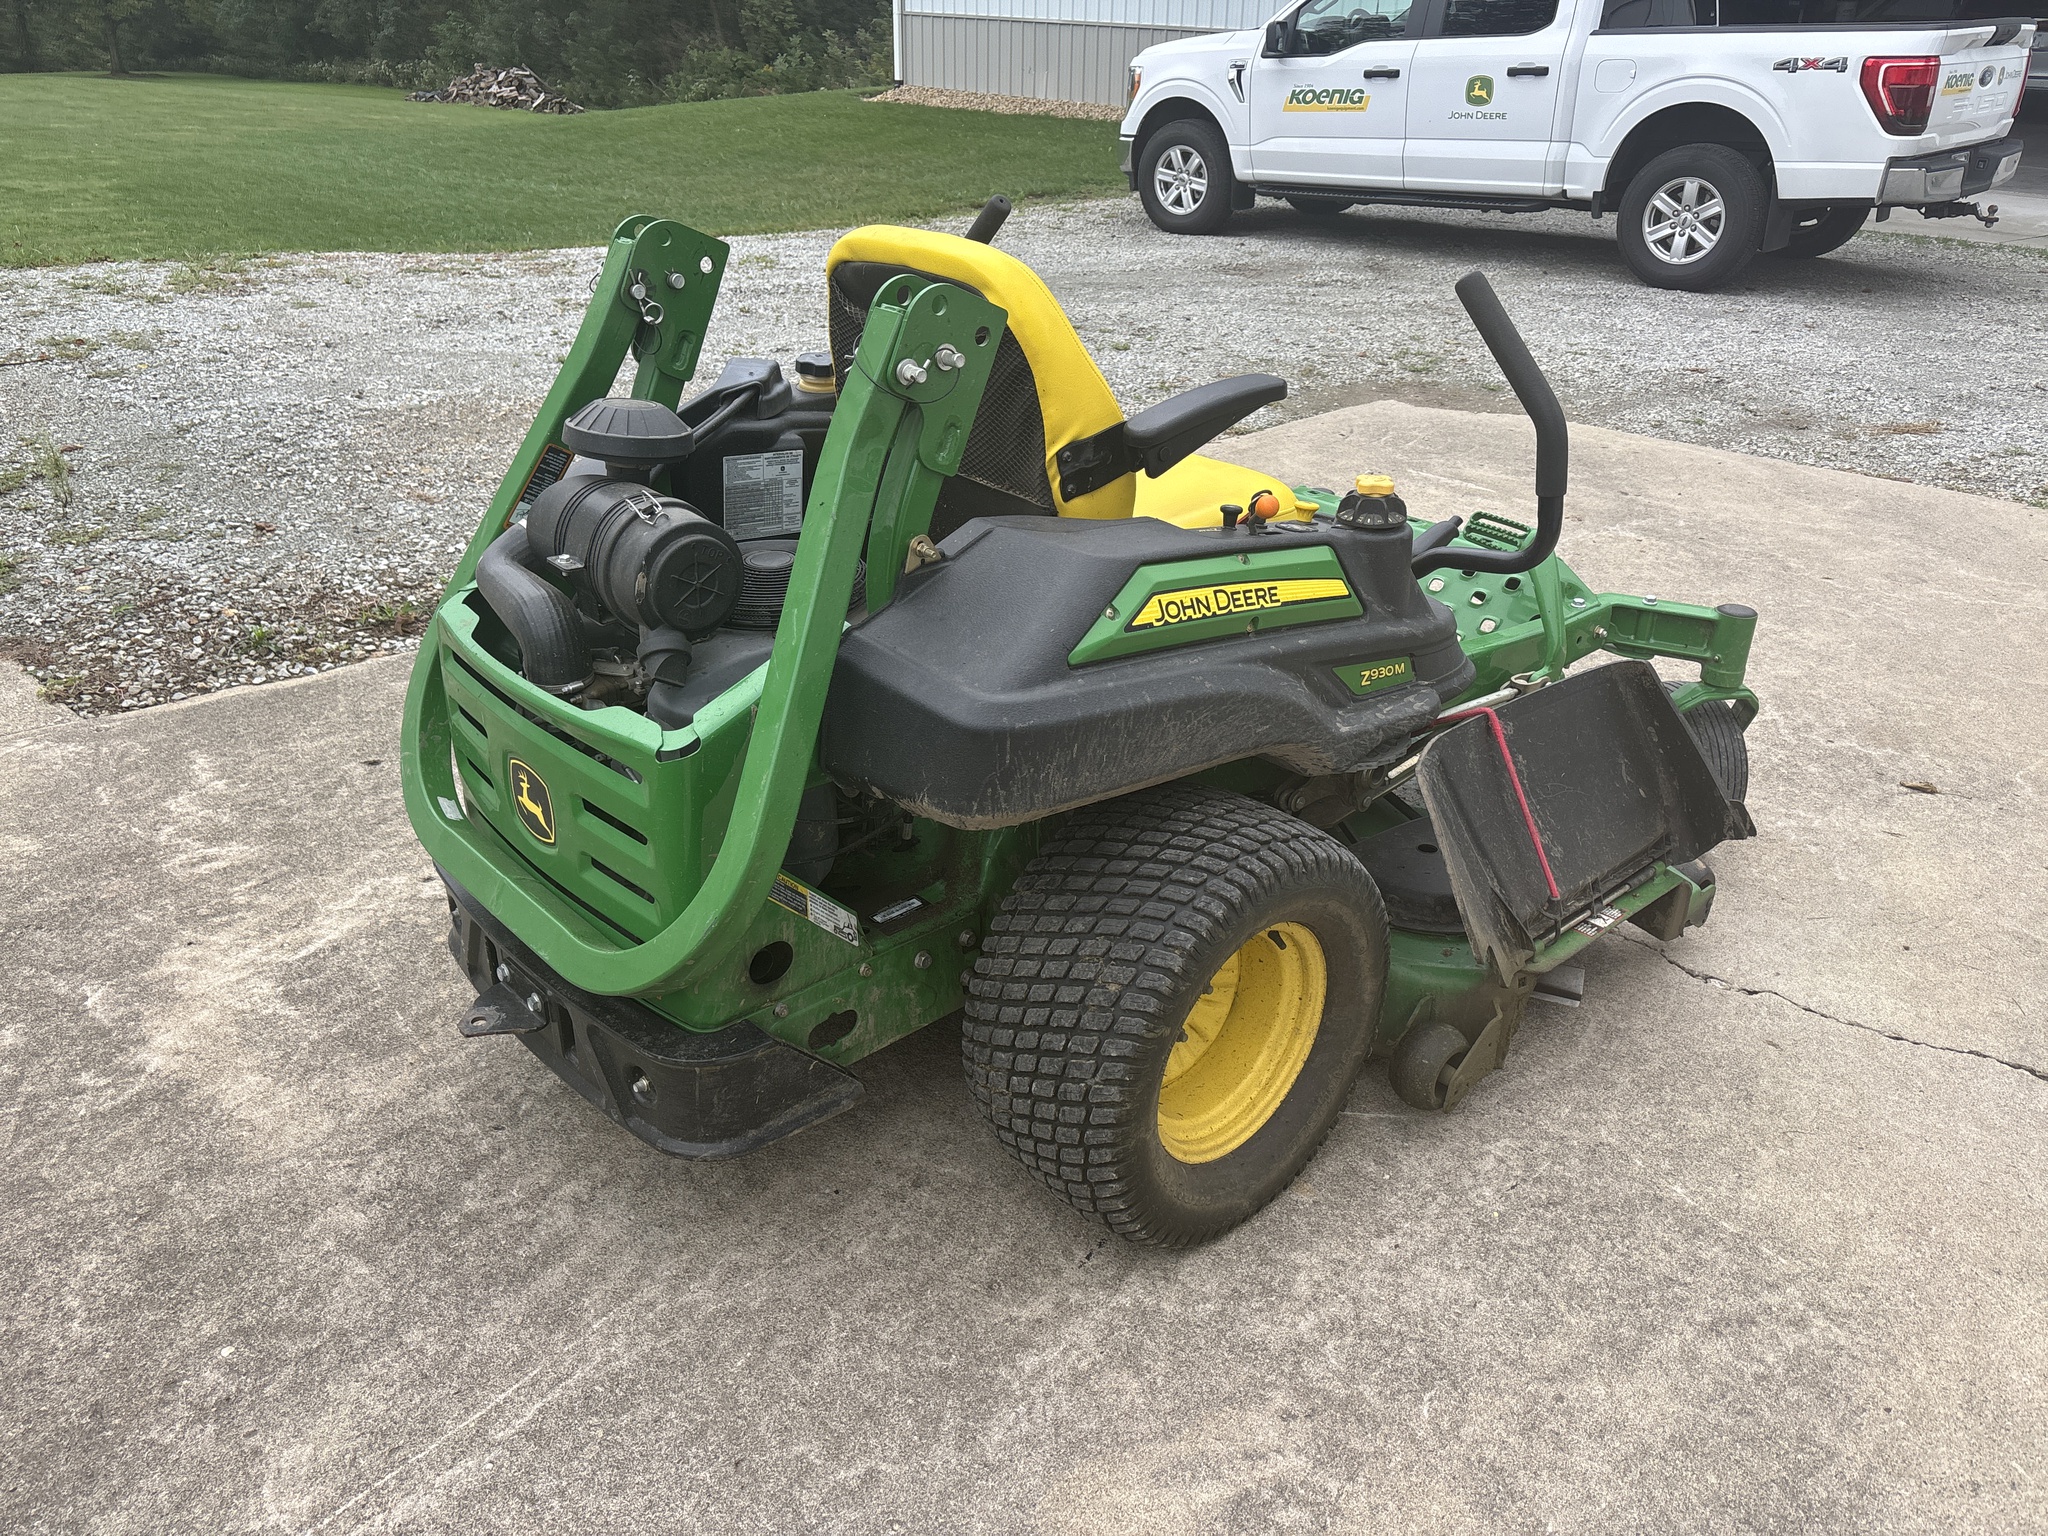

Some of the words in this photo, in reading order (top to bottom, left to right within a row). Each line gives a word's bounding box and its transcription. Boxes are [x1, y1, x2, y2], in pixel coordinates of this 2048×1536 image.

[1448, 111, 1474, 120] JOHN
[1475, 111, 1508, 120] DEERE
[1154, 598, 1212, 623] JOHN
[1213, 586, 1281, 612] DEERE
[1360, 662, 1405, 686] Z930M
[778, 874, 799, 890] CAUTION
